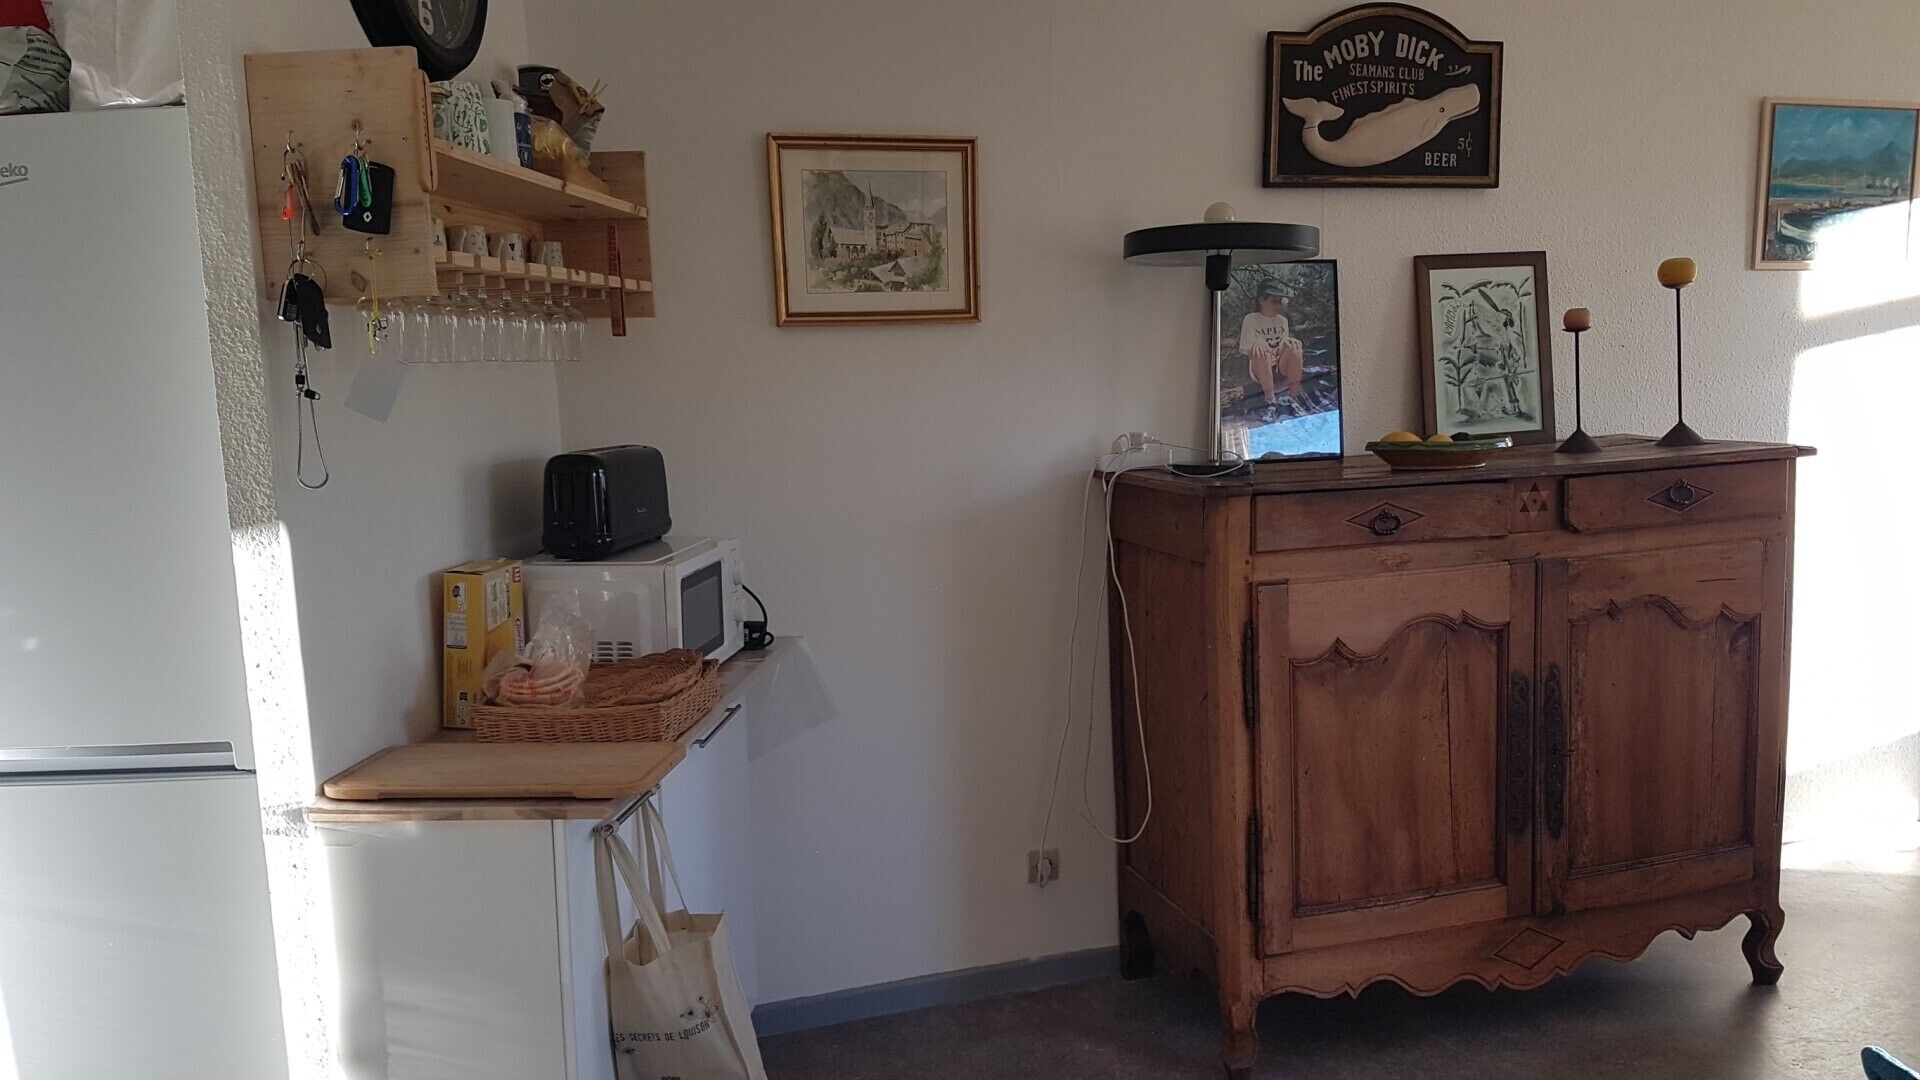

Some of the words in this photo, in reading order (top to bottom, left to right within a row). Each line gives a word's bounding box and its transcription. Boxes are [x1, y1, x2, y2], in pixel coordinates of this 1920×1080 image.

[1293, 60, 1323, 82] The
[1323, 30, 1385, 69] MOBY
[1395, 32, 1445, 71] DICK
[1349, 63, 1395, 79] SEAMANS
[1399, 66, 1425, 81] CLUB
[1331, 81, 1370, 104] FINEST
[1370, 81, 1415, 96] SPIRITS
[1424, 152, 1457, 167] BEER
[0, 163, 29, 178] eko
[629, 1032, 661, 1041] SECRETS
[665, 1032, 676, 1041] DE
[679, 1020, 711, 1040] LOUISON
